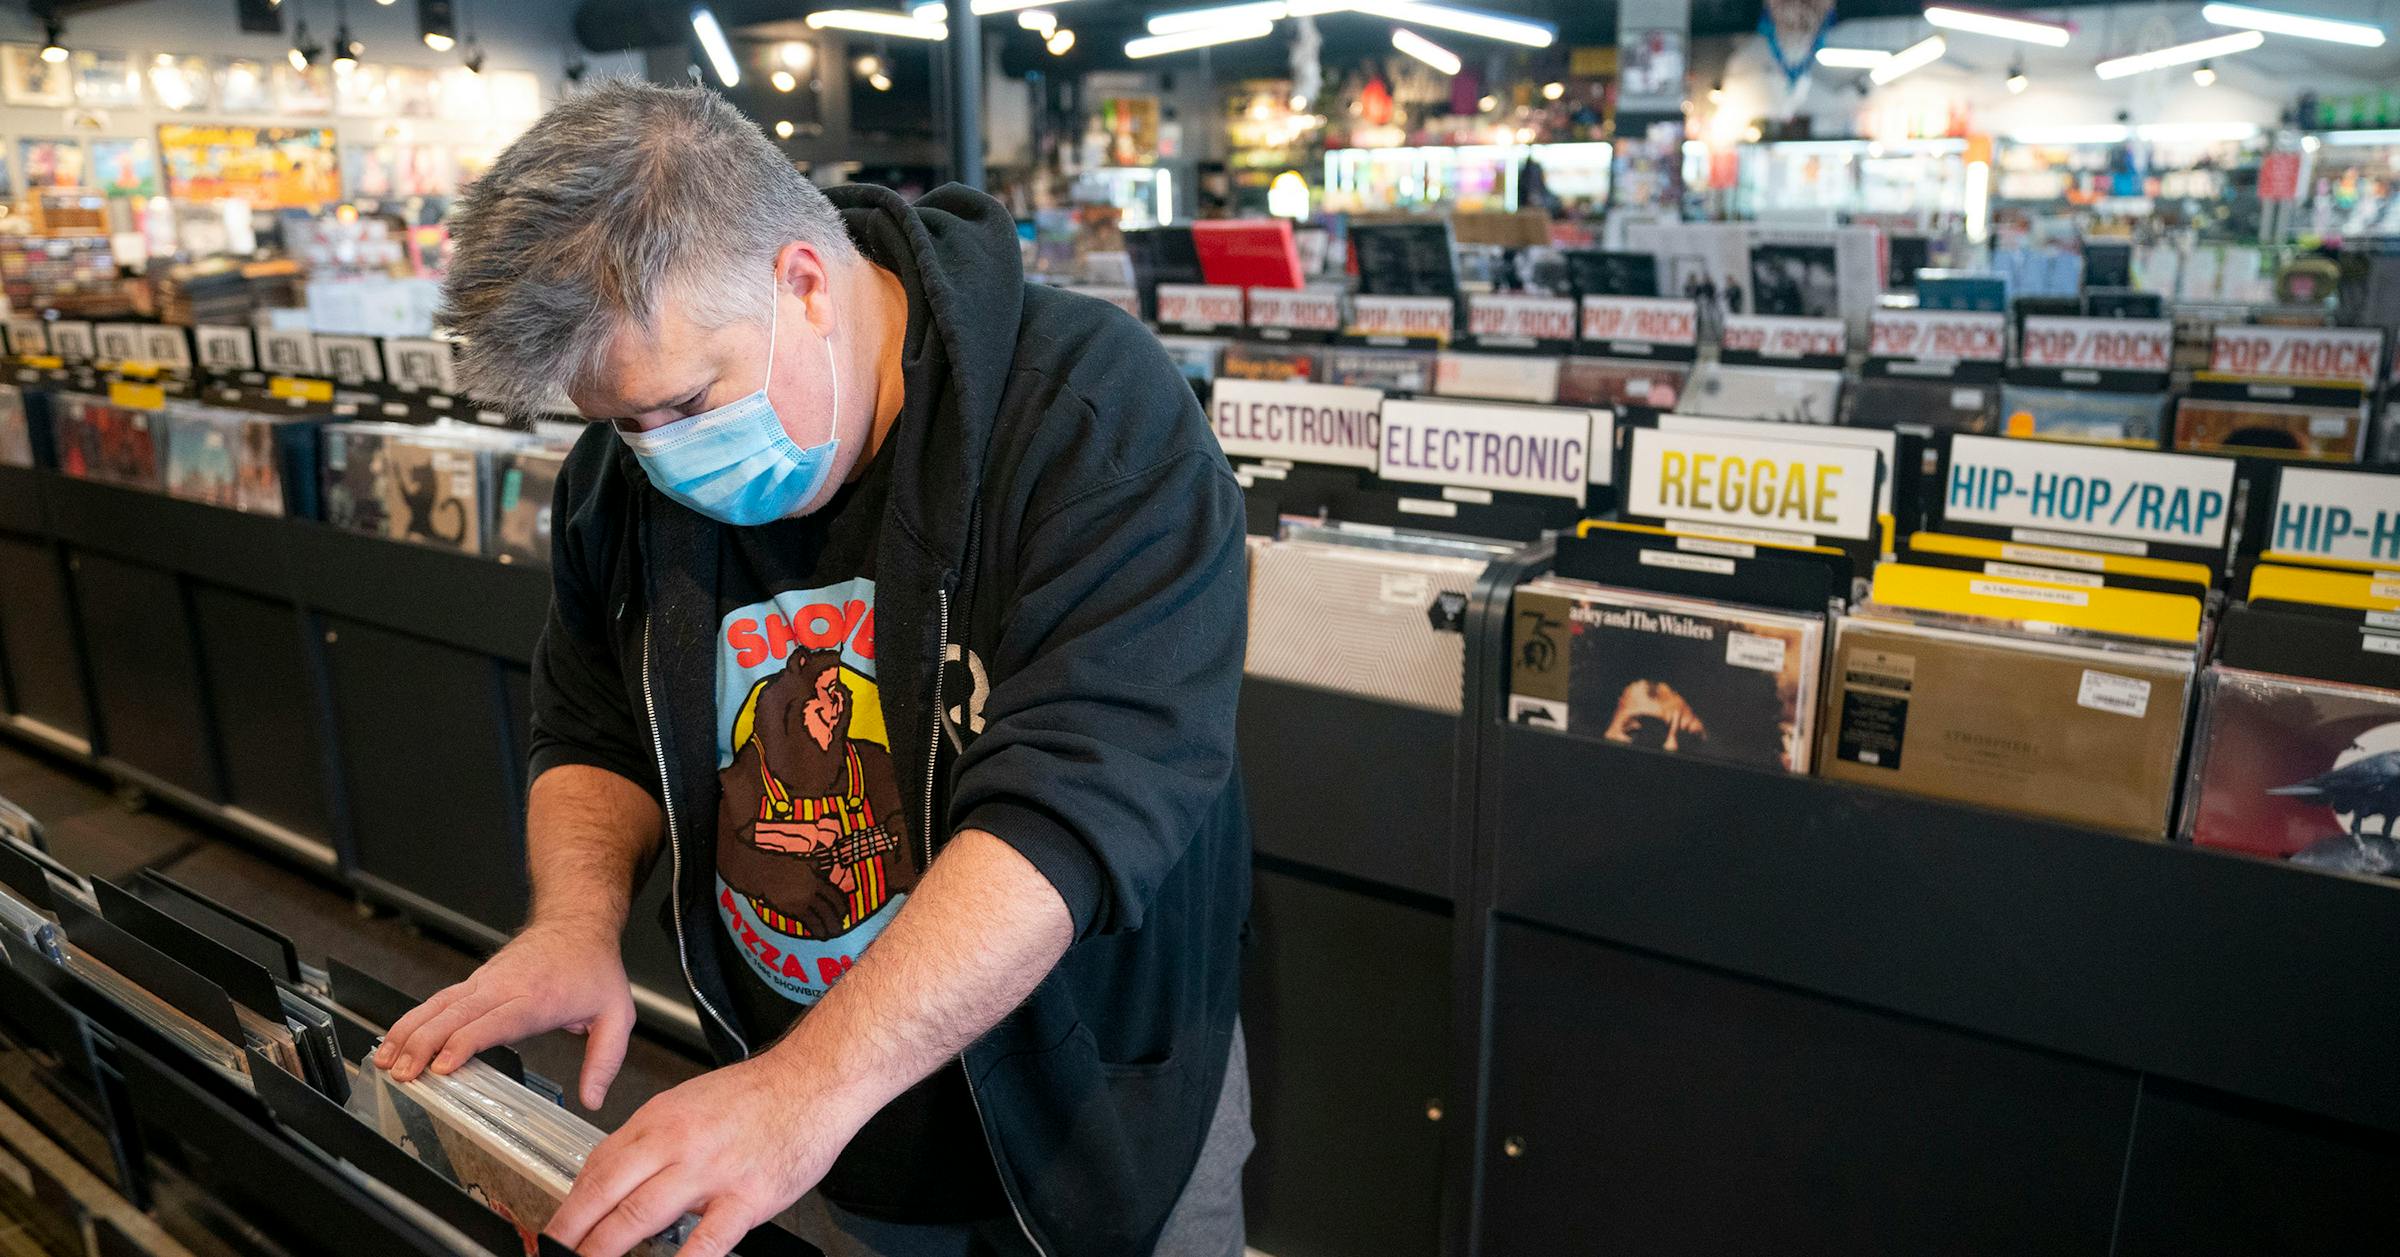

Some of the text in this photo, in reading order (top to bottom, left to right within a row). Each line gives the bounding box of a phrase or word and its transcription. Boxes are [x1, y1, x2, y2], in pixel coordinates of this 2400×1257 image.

[1469, 303, 1574, 340] POP/ROCK
[1583, 307, 1695, 341] POP/ROCK
[1724, 326, 1843, 355] POP/ROCK
[1872, 318, 2002, 357] POP/ROCK
[2025, 325, 2169, 368] POP/ROCK
[2213, 337, 2376, 380] POP/ROCK
[1219, 401, 1379, 450] ELECTRONIC
[1386, 424, 1582, 483] ELECTRONIC
[1659, 450, 1843, 524] REGGAE
[1950, 463, 2224, 536] HIP-HOP/RAP
[1603, 610, 1631, 629] and
[1632, 611, 1658, 632] The
[1658, 614, 1715, 641] Wailers
[720, 887, 809, 984] PIZZA
[773, 975, 822, 998] SHOWBIZ
